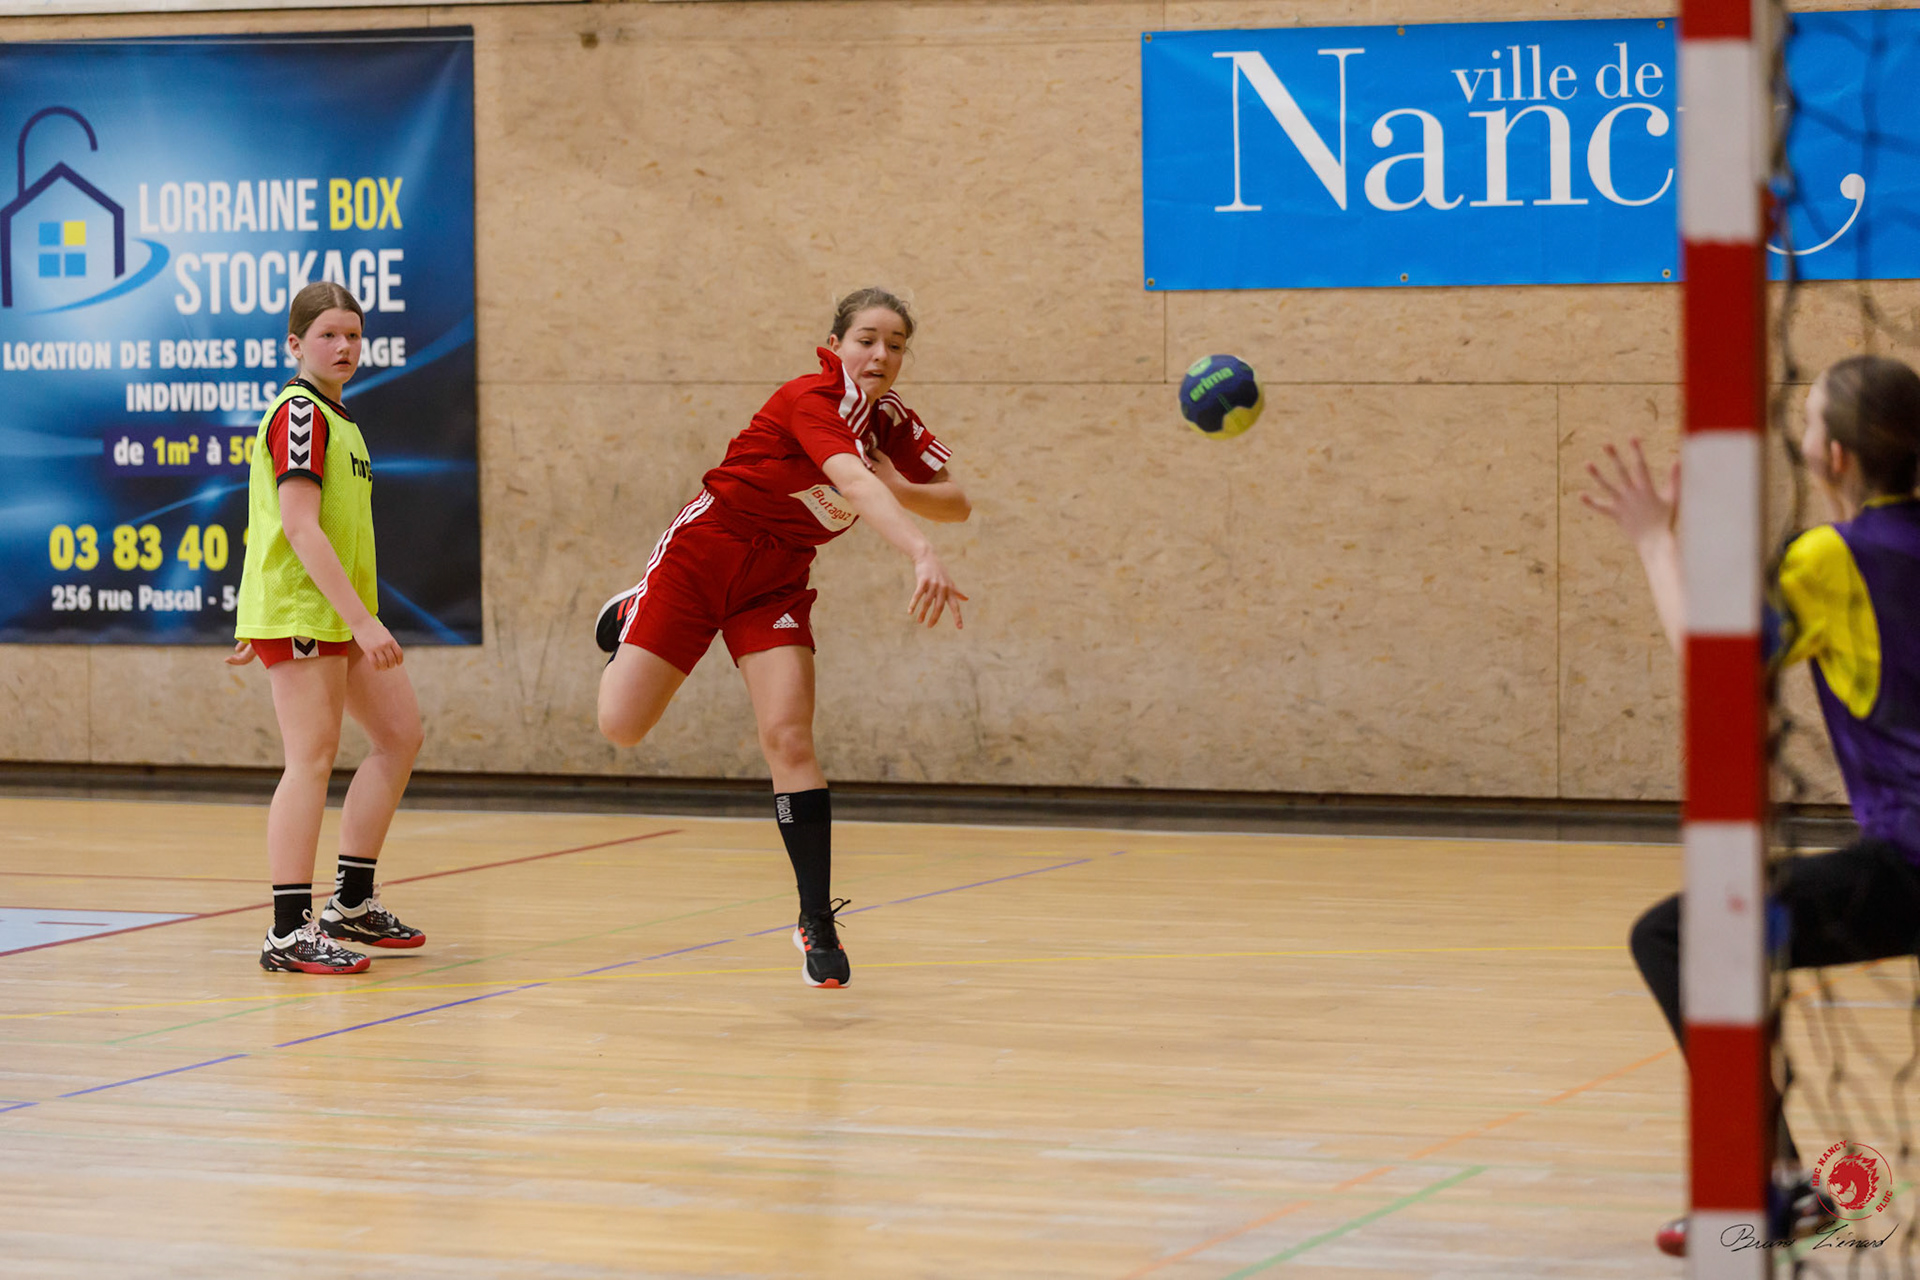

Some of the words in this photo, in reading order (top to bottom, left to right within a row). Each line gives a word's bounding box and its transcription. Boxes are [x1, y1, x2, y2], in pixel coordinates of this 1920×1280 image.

[1451, 44, 1578, 103] ville
[1595, 42, 1663, 98] de
[1212, 48, 1866, 255] Nanc
[139, 179, 318, 234] LORRAINE
[329, 177, 403, 230] BOX
[3, 341, 111, 371] LOCATION
[120, 341, 151, 369] DE
[159, 339, 237, 368] BOXES
[245, 339, 277, 368] DE
[126, 382, 278, 412] INDIVIDUELS
[113, 436, 144, 466] de
[153, 434, 200, 465] 1m²
[206, 435, 222, 465] à
[812, 489, 852, 521] Butagaz
[49, 524, 99, 571] 03
[113, 524, 163, 571] 83
[178, 524, 229, 571] 40
[52, 585, 91, 611] 256
[99, 590, 132, 611] rue
[139, 584, 202, 611] Pascal
